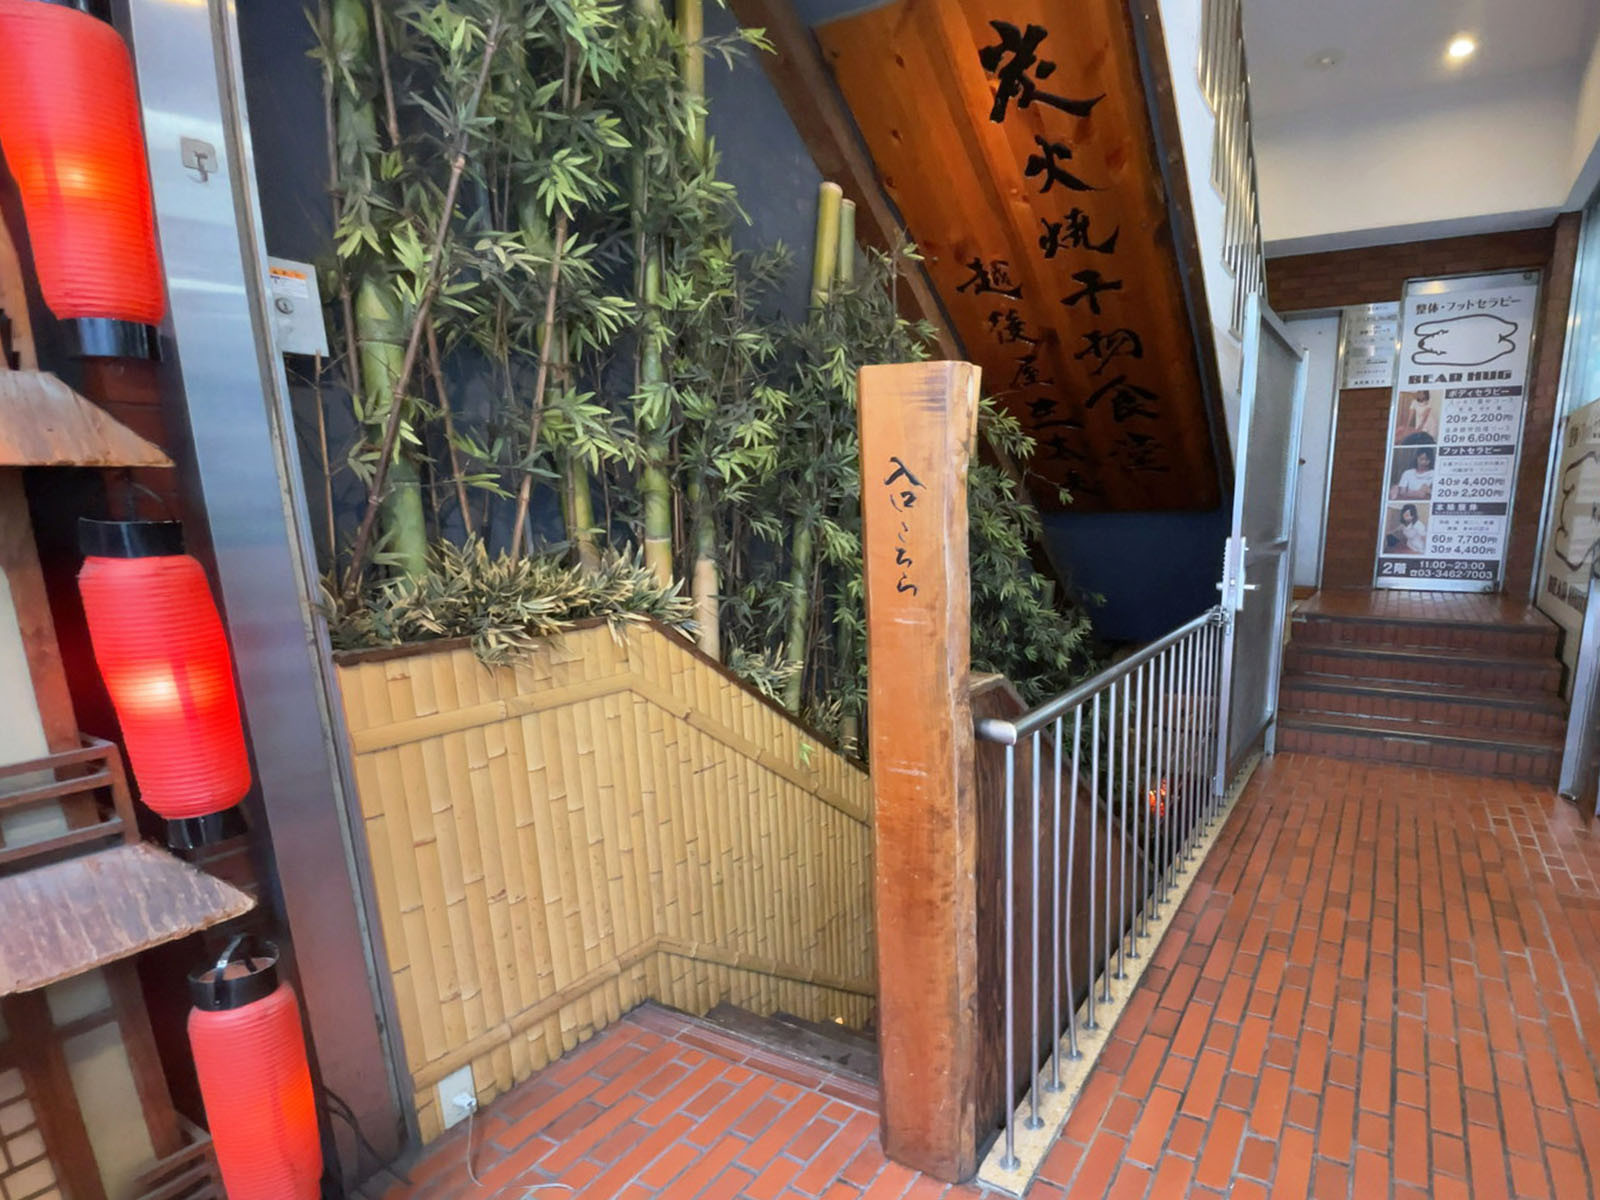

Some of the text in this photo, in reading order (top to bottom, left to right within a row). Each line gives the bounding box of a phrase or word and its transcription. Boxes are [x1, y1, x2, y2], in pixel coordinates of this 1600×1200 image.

[1408, 370, 1512, 385] BEAR HUG
[1442, 446, 1502, 455] フットセラピー
[1382, 561, 1407, 574] 2階
